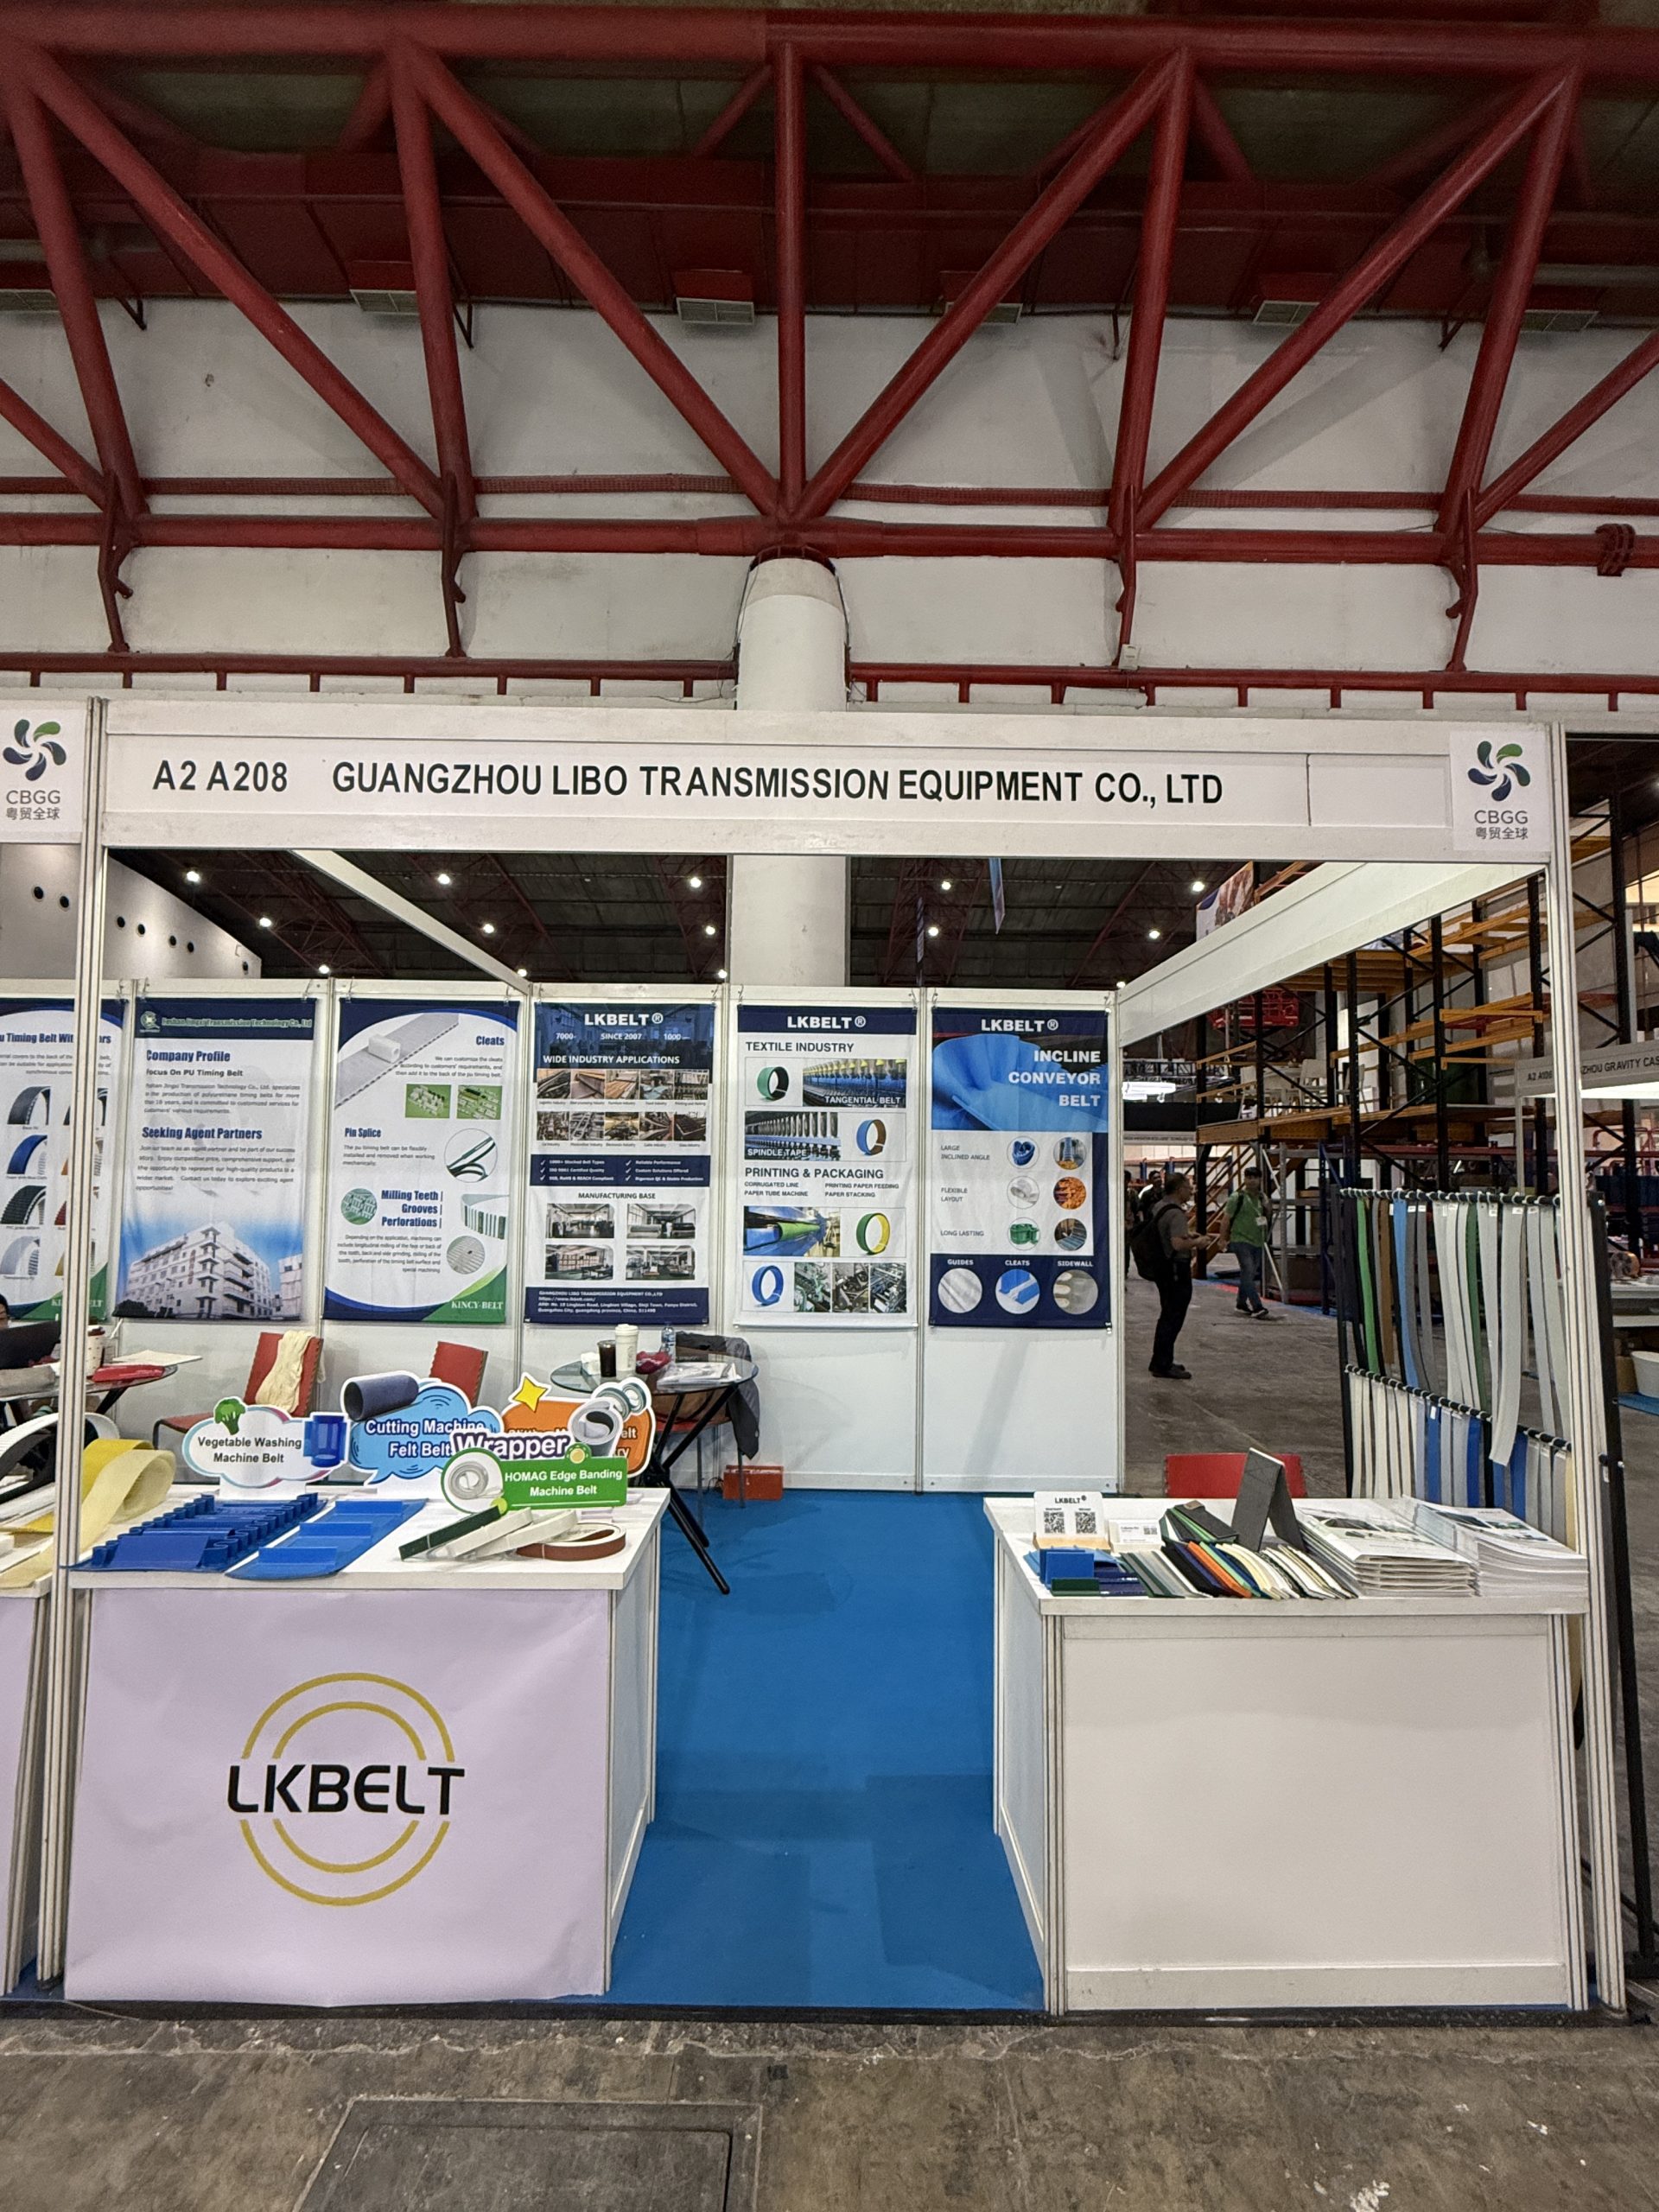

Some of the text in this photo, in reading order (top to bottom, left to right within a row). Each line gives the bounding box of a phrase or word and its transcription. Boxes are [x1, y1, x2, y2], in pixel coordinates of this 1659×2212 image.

[152, 760, 197, 791] A2
[206, 760, 288, 792] A208
[332, 761, 542, 795] GUANGZHOU
[552, 765, 627, 796] LIBO
[639, 766, 889, 800] TRANSMISSION
[899, 769, 1083, 802] EQUIPMENT
[1166, 773, 1223, 804] LTD
[6, 790, 60, 804] CBGG
[6, 807, 60, 821] 粤贸全球
[1474, 810, 1529, 824] CBGG
[1476, 827, 1529, 840] 粤贸全球
[6, 1033, 73, 1044] Timing Belt Wit
[476, 1035, 505, 1046] Cleats
[746, 1041, 855, 1052] TEXTILE INDUSTRY
[146, 1050, 231, 1063] Company Profile
[543, 1055, 681, 1065] WIDE INDUSTRY APPLICATIONS
[1034, 1050, 1101, 1063] INCLINE
[1604, 1058, 1641, 1072] GRAVITY
[1008, 1071, 1101, 1084] CONVEYOR
[1058, 1095, 1101, 1107] BELT
[142, 1127, 263, 1141] Seeking Agent Partners
[345, 1128, 381, 1139] Pin Splice
[745, 1168, 884, 1179] PRINTING & PACKAGING
[381, 1190, 438, 1201] Milling Teeth
[402, 1204, 438, 1214] Grooves
[382, 1217, 437, 1227] Perforations
[365, 1420, 420, 1437] Cutting
[621, 1428, 636, 1439] elt
[198, 1436, 302, 1450] Vegetable Washing
[456, 1434, 568, 1460] Wrapper
[390, 1443, 417, 1458] Felt
[213, 1452, 284, 1463] Machine Belt
[505, 1469, 623, 1483] HOMAG Edge Banding
[530, 1484, 597, 1497] Machine Belt
[227, 1764, 466, 1815] LKBELT
